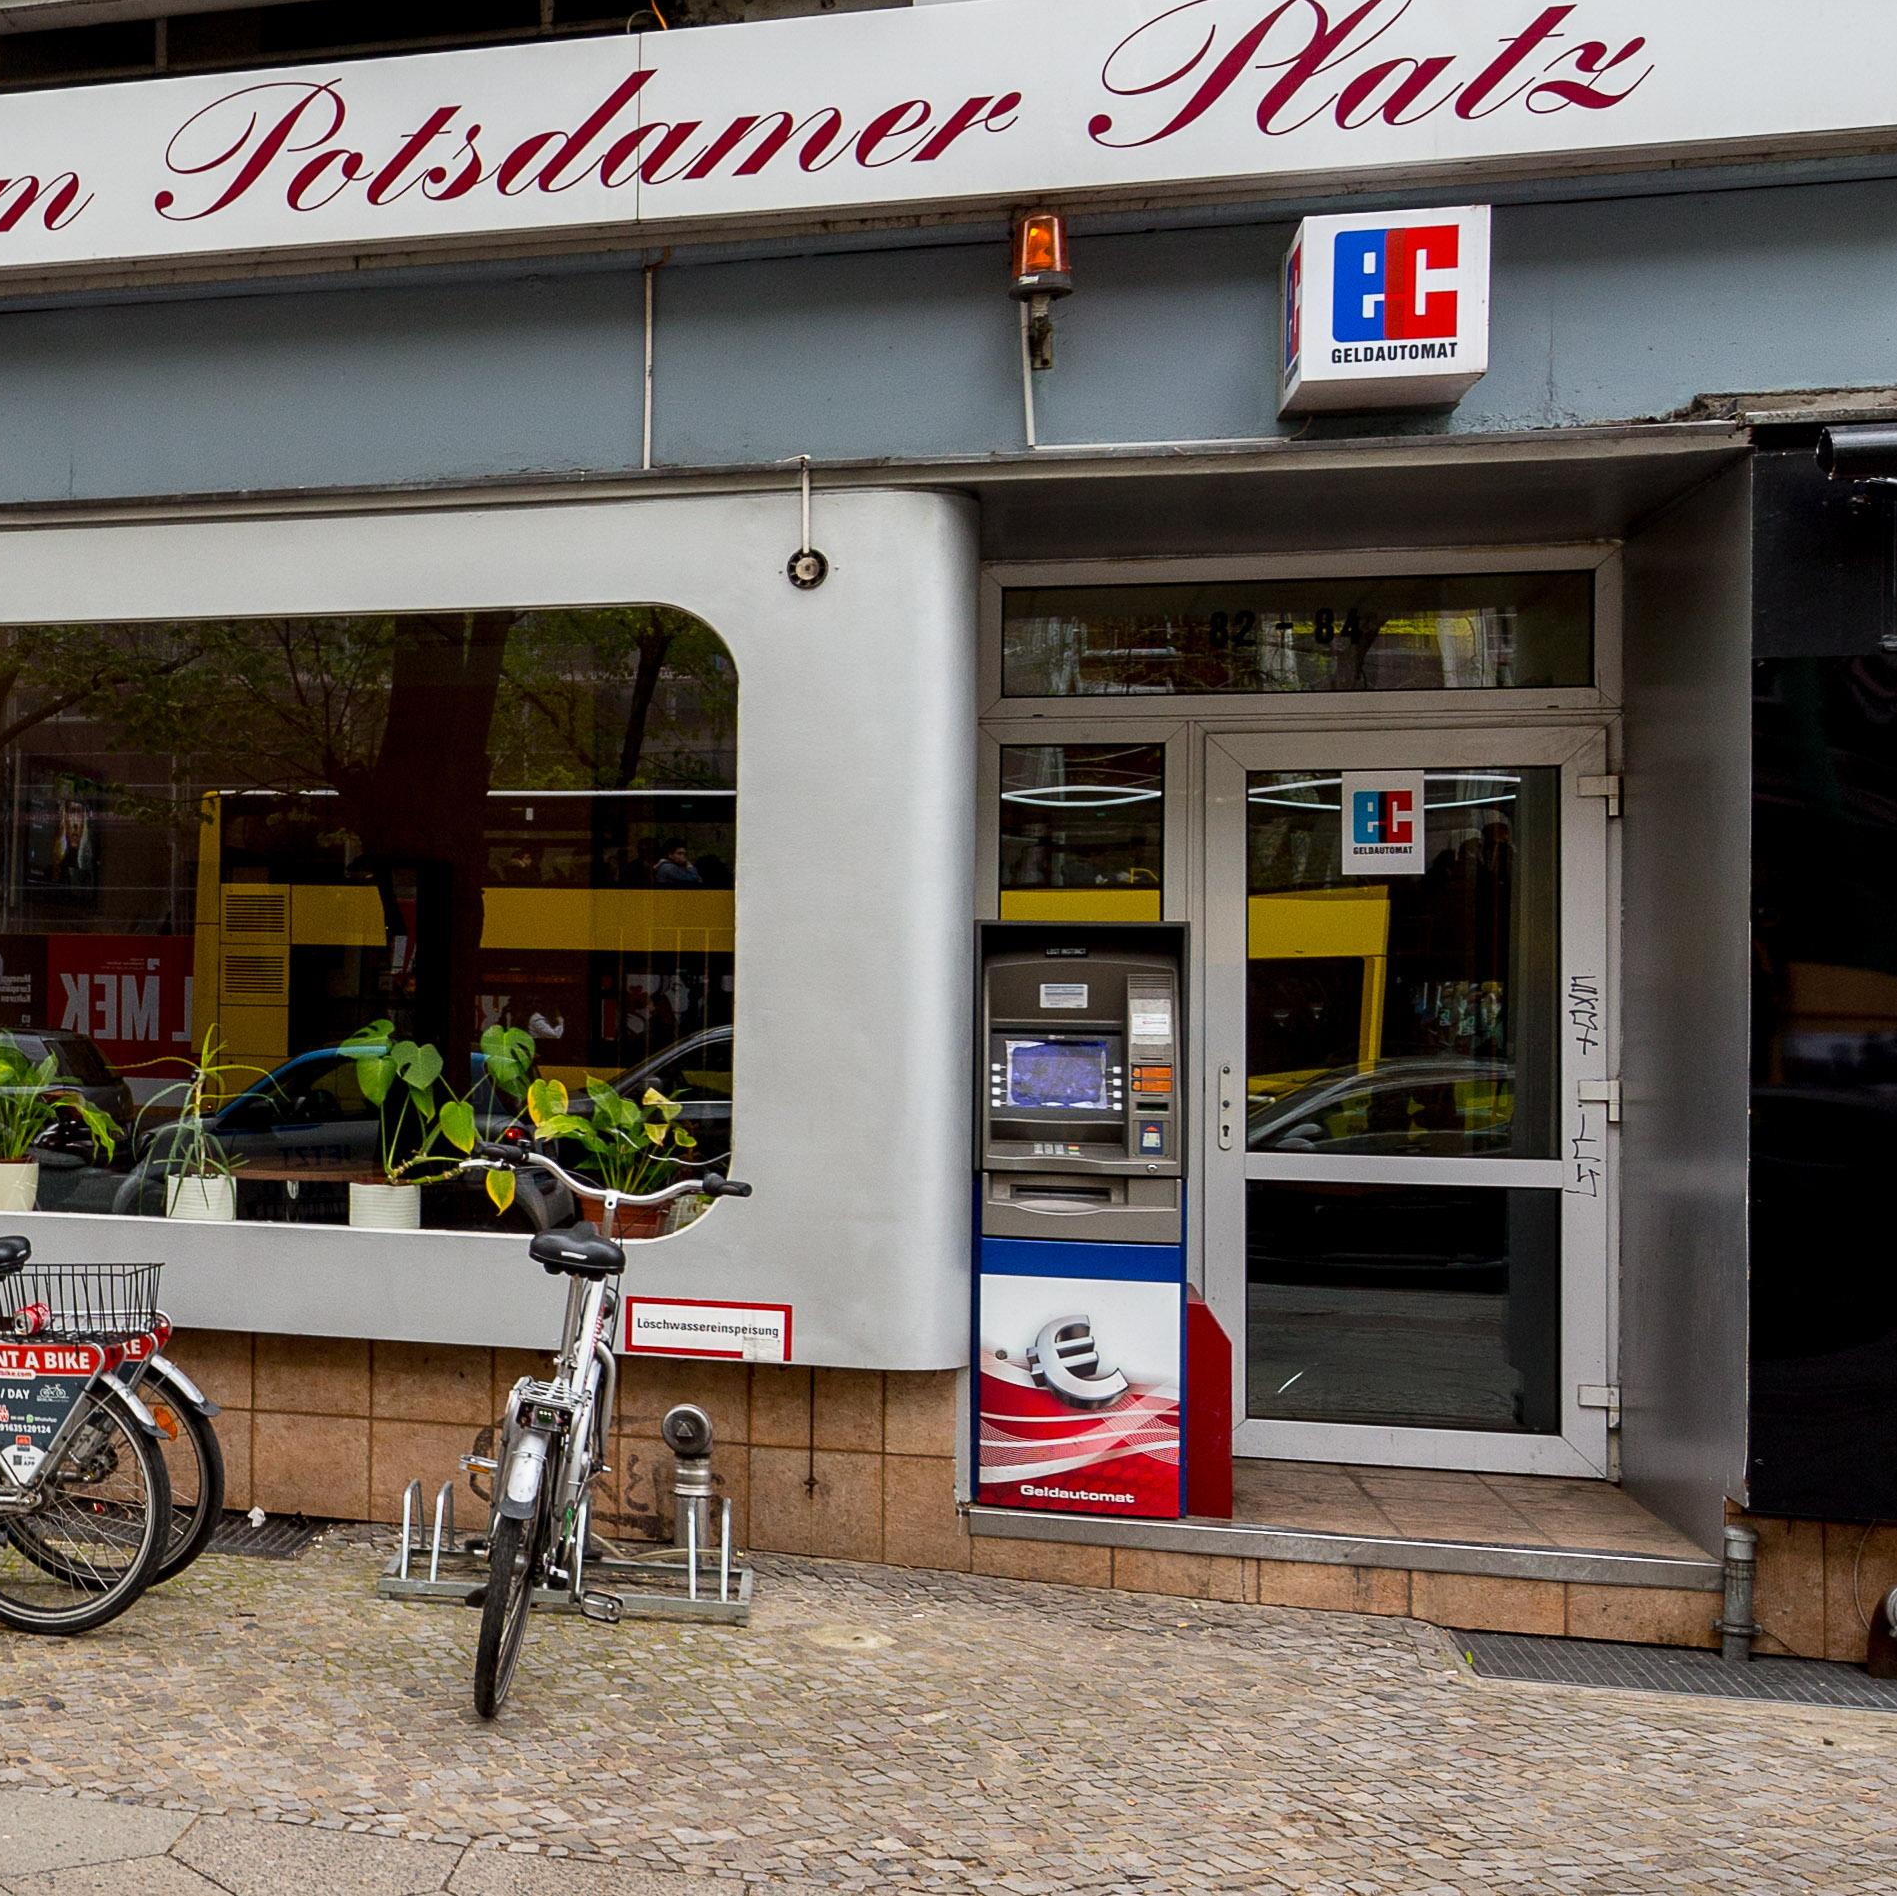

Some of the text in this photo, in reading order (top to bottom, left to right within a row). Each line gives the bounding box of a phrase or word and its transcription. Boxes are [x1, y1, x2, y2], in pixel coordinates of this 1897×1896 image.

[154, 69, 1021, 222] Potsdamer
[1331, 342, 1457, 364] GELDAUTOMAT
[1208, 610, 1257, 648] 82
[1314, 607, 1363, 644] 84
[1352, 846, 1413, 855] GELDAUTOMAT
[637, 1317, 779, 1339] Löschwassereinspeisung
[24, 1350, 40, 1369] A
[43, 1351, 90, 1370] BIKE
[7, 1388, 30, 1400] DAY
[1020, 1484, 1135, 1504] Geldautomat
